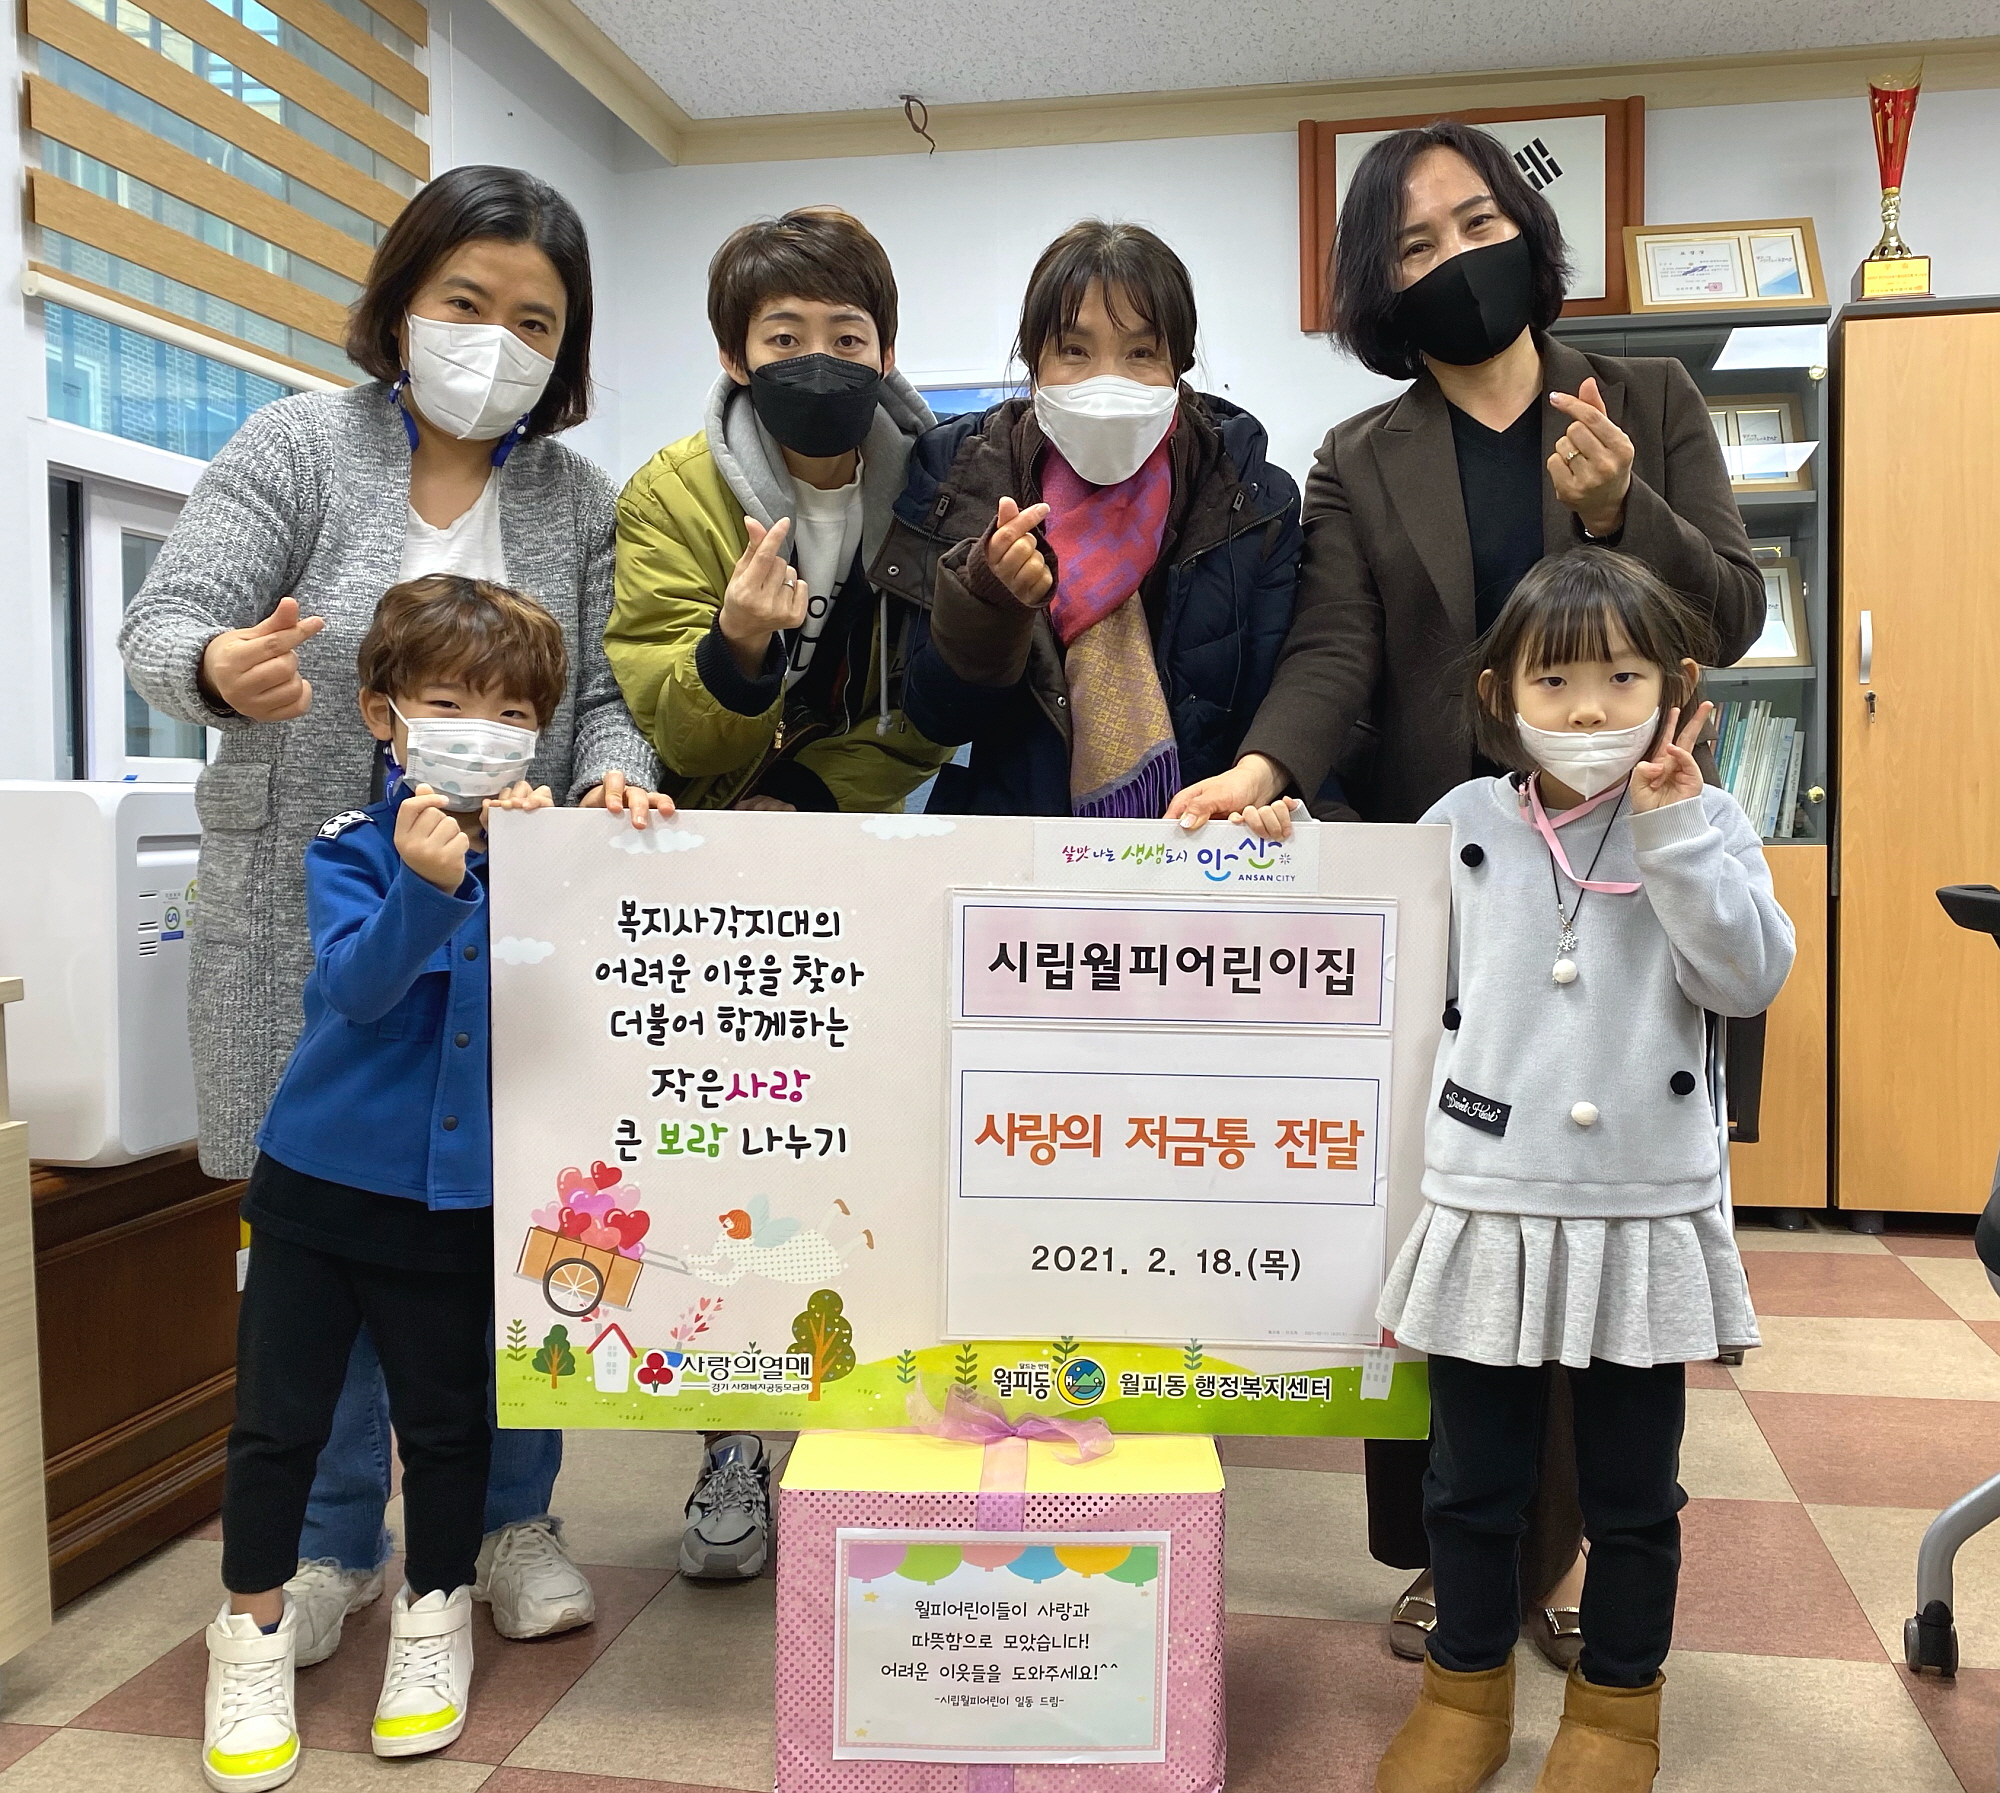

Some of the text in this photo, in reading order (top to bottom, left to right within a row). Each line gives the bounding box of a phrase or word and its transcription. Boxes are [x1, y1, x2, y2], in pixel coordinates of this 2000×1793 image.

[1062, 845, 1091, 863] 살맛
[1093, 848, 1116, 862] 나는
[1238, 874, 1296, 882] ANSAN CITY
[617, 900, 841, 943] 복지사각지대의
[595, 954, 865, 997] 어려운 이웃을 찾아
[988, 941, 1356, 996] 시립월피어린이집
[610, 1003, 849, 1048] 더불어 함께하는
[614, 1119, 846, 1162] 큰 보람 나누기
[974, 1113, 1365, 1171] 사랑의 저금통 전달
[1031, 1245, 1128, 1275] 2021.
[1147, 1247, 1176, 1276] 2.
[680, 1355, 810, 1381] 사랑의열매
[711, 1383, 810, 1392] 경기 사회복지공동모금회
[994, 1368, 1051, 1399] 월피동
[1119, 1373, 1333, 1401] 월피동 행정복지센터
[914, 1600, 1090, 1622] 월피어린이들이 사랑과
[912, 1632, 1089, 1652] 따뜻함으로 모았습니다!
[881, 1662, 929, 1682] 어려운
[939, 1664, 1002, 1683] 이웃들을
[1015, 1696, 1034, 1708] 일동
